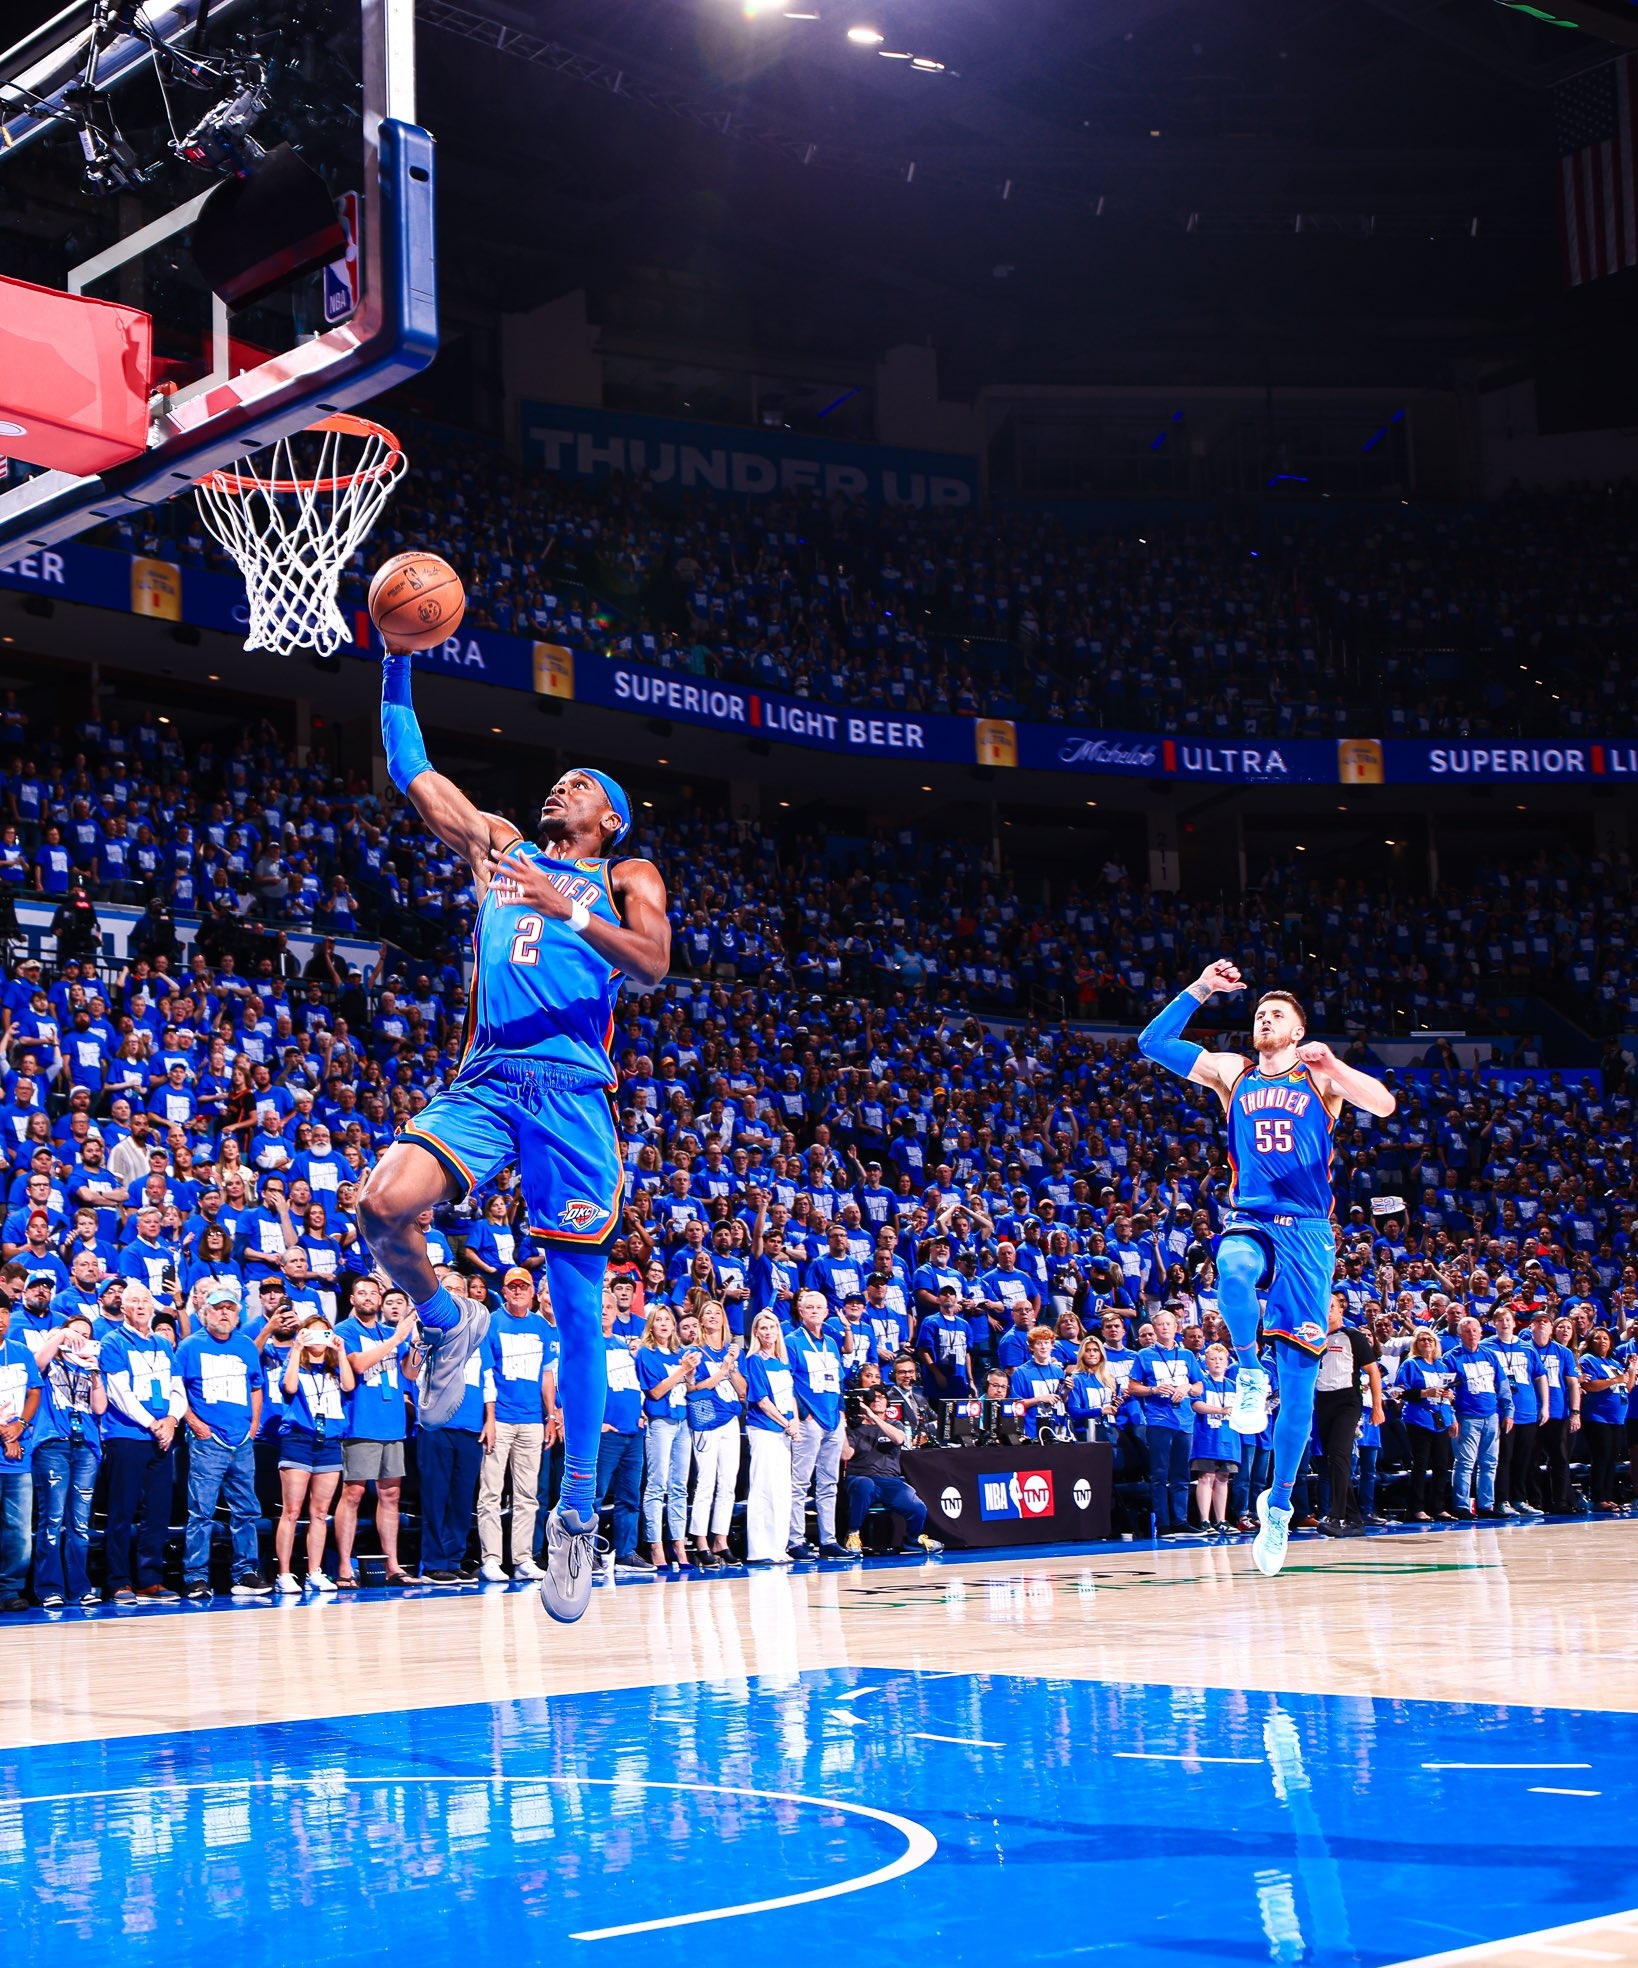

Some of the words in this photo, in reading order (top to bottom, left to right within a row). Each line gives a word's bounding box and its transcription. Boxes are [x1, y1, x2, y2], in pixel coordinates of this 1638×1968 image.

[329, 290, 346, 314] NBA
[528, 426, 869, 502] THUNDER
[881, 470, 971, 511] UP
[614, 671, 745, 722] SUPERIOR
[765, 702, 838, 739] LIGHT
[847, 719, 925, 748] BEER
[1182, 746, 1288, 773] ULTRA
[1429, 749, 1585, 773] SUPERIOR
[509, 913, 545, 966] 2
[1239, 1086, 1311, 1118] THUNDER
[1254, 1119, 1295, 1154] 55
[564, 1207, 593, 1221] OKC
[940, 1497, 963, 1511] TNT
[984, 1482, 1009, 1511] NBA
[1023, 1488, 1050, 1503] TNT
[1073, 1488, 1092, 1502] TNT
